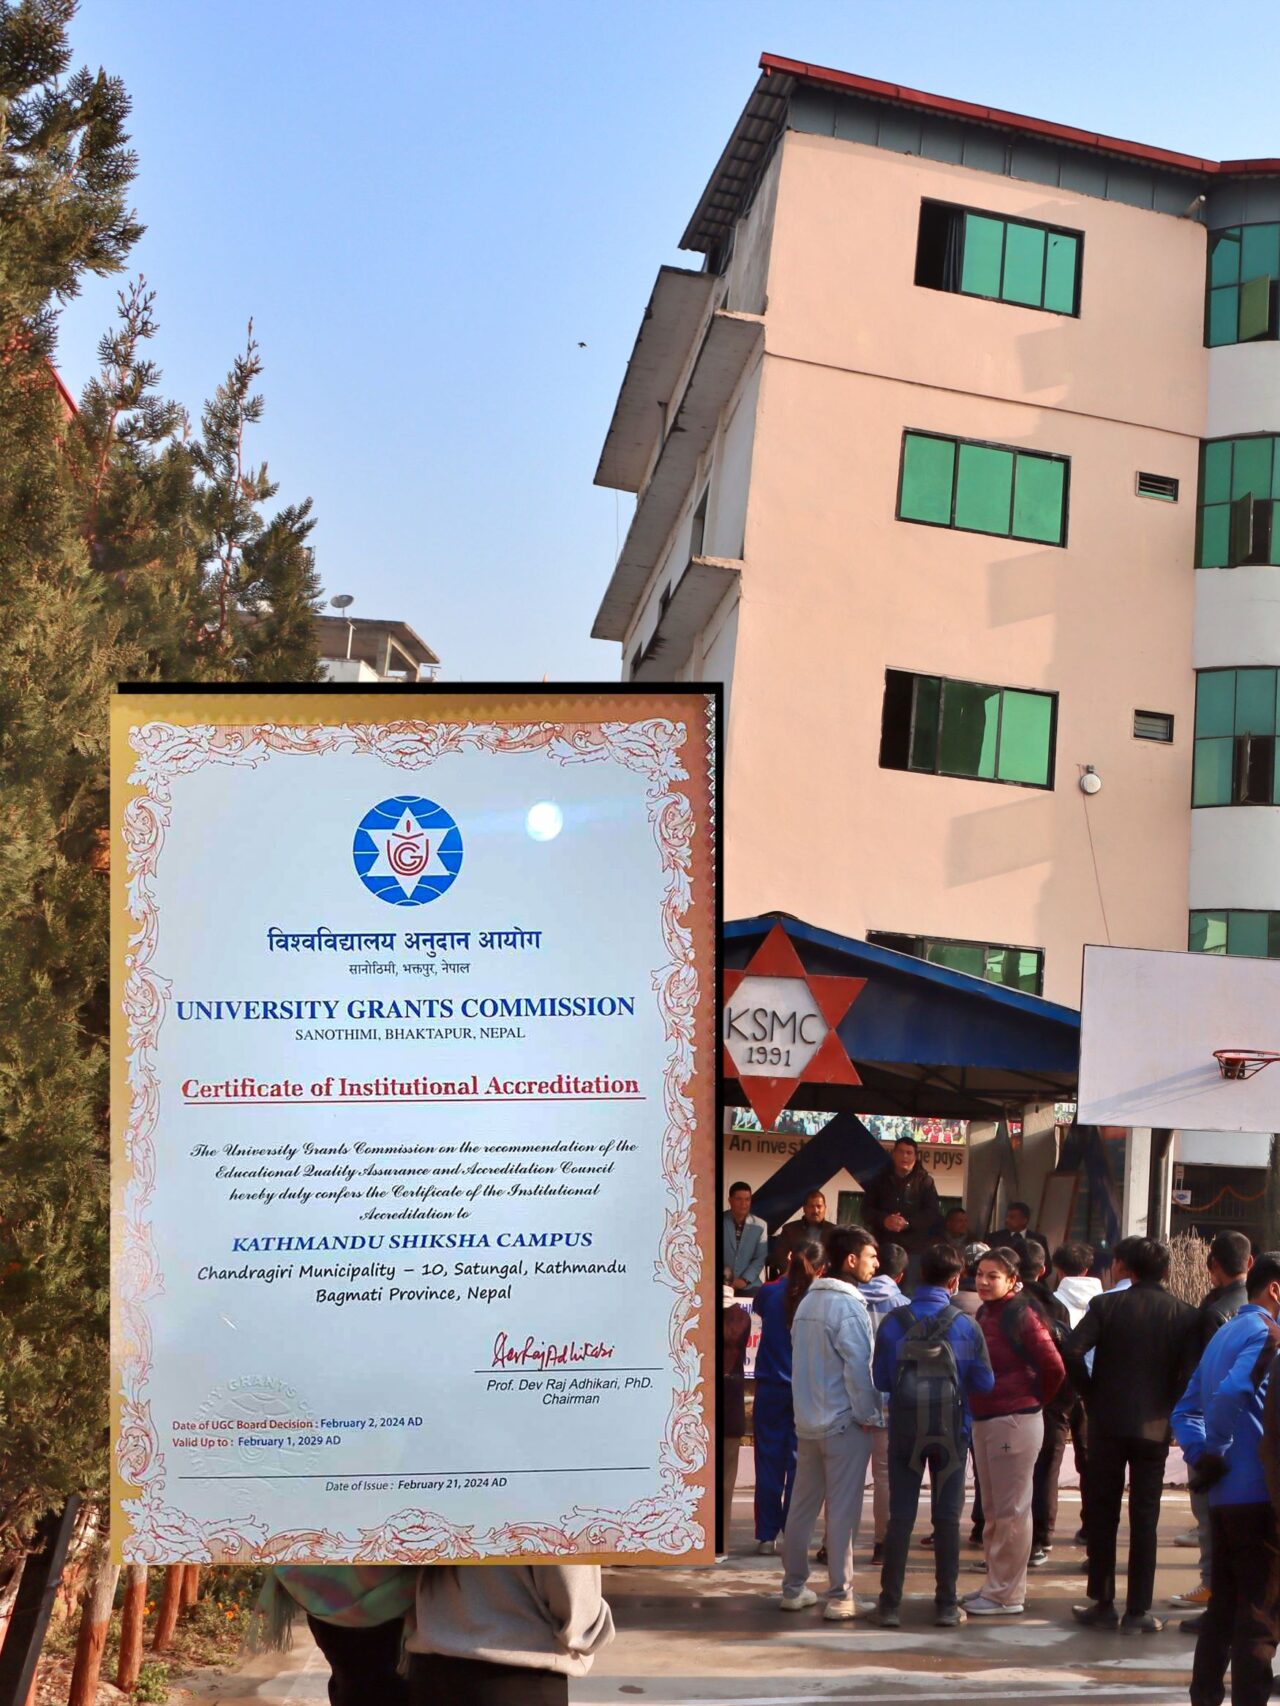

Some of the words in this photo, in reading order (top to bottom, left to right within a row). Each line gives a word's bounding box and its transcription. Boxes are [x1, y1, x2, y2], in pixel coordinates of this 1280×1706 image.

[267, 926, 396, 952] विश्वविद्यालय
[404, 930, 470, 957] अनुदान
[478, 926, 542, 949] आयोग
[441, 959, 470, 974] नेपाल
[176, 999, 340, 1021] UNIVERSITY
[346, 998, 453, 1019] GRANTS
[460, 996, 635, 1018] COMMISSION
[295, 1028, 381, 1042] SANOTHIMI,
[385, 1027, 476, 1041] BHAKTAPUR,
[479, 1026, 525, 1040] NEPAL
[727, 1007, 818, 1046] KSMC
[746, 1046, 792, 1067] 1991
[181, 1077, 305, 1099] Certificate
[310, 1077, 335, 1097] of
[338, 1074, 478, 1097] Institutional
[485, 1073, 641, 1094] Accreditation
[189, 1143, 217, 1157] The
[223, 1143, 299, 1161] University
[302, 1142, 348, 1155] Grants
[353, 1141, 436, 1155] Commission
[438, 1145, 455, 1154] on
[455, 1141, 480, 1153] the
[483, 1140, 597, 1153] recommendation
[599, 1139, 615, 1156] of
[616, 1139, 638, 1152] the
[729, 1134, 751, 1152] An
[933, 1150, 963, 1170] pays
[215, 1165, 301, 1179] Educational
[302, 1164, 358, 1181] Quality
[358, 1163, 431, 1177] Assurance
[432, 1163, 461, 1175] and
[461, 1162, 557, 1175] Accreditation
[560, 1160, 615, 1174] Council
[229, 1188, 280, 1205] hereby
[278, 1187, 314, 1205] duly
[315, 1186, 363, 1203] confers
[365, 1186, 389, 1198] the
[391, 1184, 464, 1202] Certificate
[465, 1184, 482, 1201] of
[482, 1184, 504, 1197] the
[507, 1183, 601, 1197] Institutional
[359, 1207, 455, 1221] Accreditation
[456, 1207, 471, 1219] to
[231, 1235, 385, 1252] KATHMANDU
[388, 1233, 492, 1250] SHIKSHA
[496, 1232, 593, 1248] CAMPUS
[197, 1264, 293, 1283] Chandragiri
[299, 1262, 396, 1282] Municipality
[421, 1263, 449, 1277] 10,
[454, 1260, 529, 1279] Satungal,
[534, 1259, 627, 1275] Kathmandu
[316, 1287, 383, 1306] Bagmati
[389, 1285, 461, 1302] Province,
[467, 1285, 512, 1303] Nepal
[487, 1379, 514, 1391] Prof.
[518, 1380, 543, 1391] Dev
[546, 1379, 566, 1392] Raj
[569, 1378, 620, 1390] Adhikari,
[624, 1377, 654, 1388] PhD.
[542, 1393, 600, 1405] Chairman
[172, 1421, 197, 1431] Date
[198, 1420, 211, 1430] of
[211, 1420, 234, 1430] UGC
[236, 1419, 267, 1430] Board
[269, 1419, 313, 1430] Decision
[320, 1417, 366, 1431] February
[366, 1417, 377, 1429] 2,
[380, 1416, 405, 1427] 2024
[406, 1416, 423, 1427] AD
[172, 1438, 198, 1447] Valid
[200, 1438, 216, 1449] Up
[217, 1438, 229, 1447] to
[238, 1437, 284, 1448] February
[286, 1436, 296, 1448] 1,
[298, 1436, 323, 1446] 2029
[325, 1435, 341, 1446] AD
[325, 1482, 349, 1492] Date
[350, 1481, 363, 1491] of
[364, 1480, 389, 1491] Issue
[398, 1478, 446, 1493] February
[448, 1478, 462, 1491] 21,
[463, 1478, 489, 1490] 2024
[491, 1477, 508, 1489] AD
